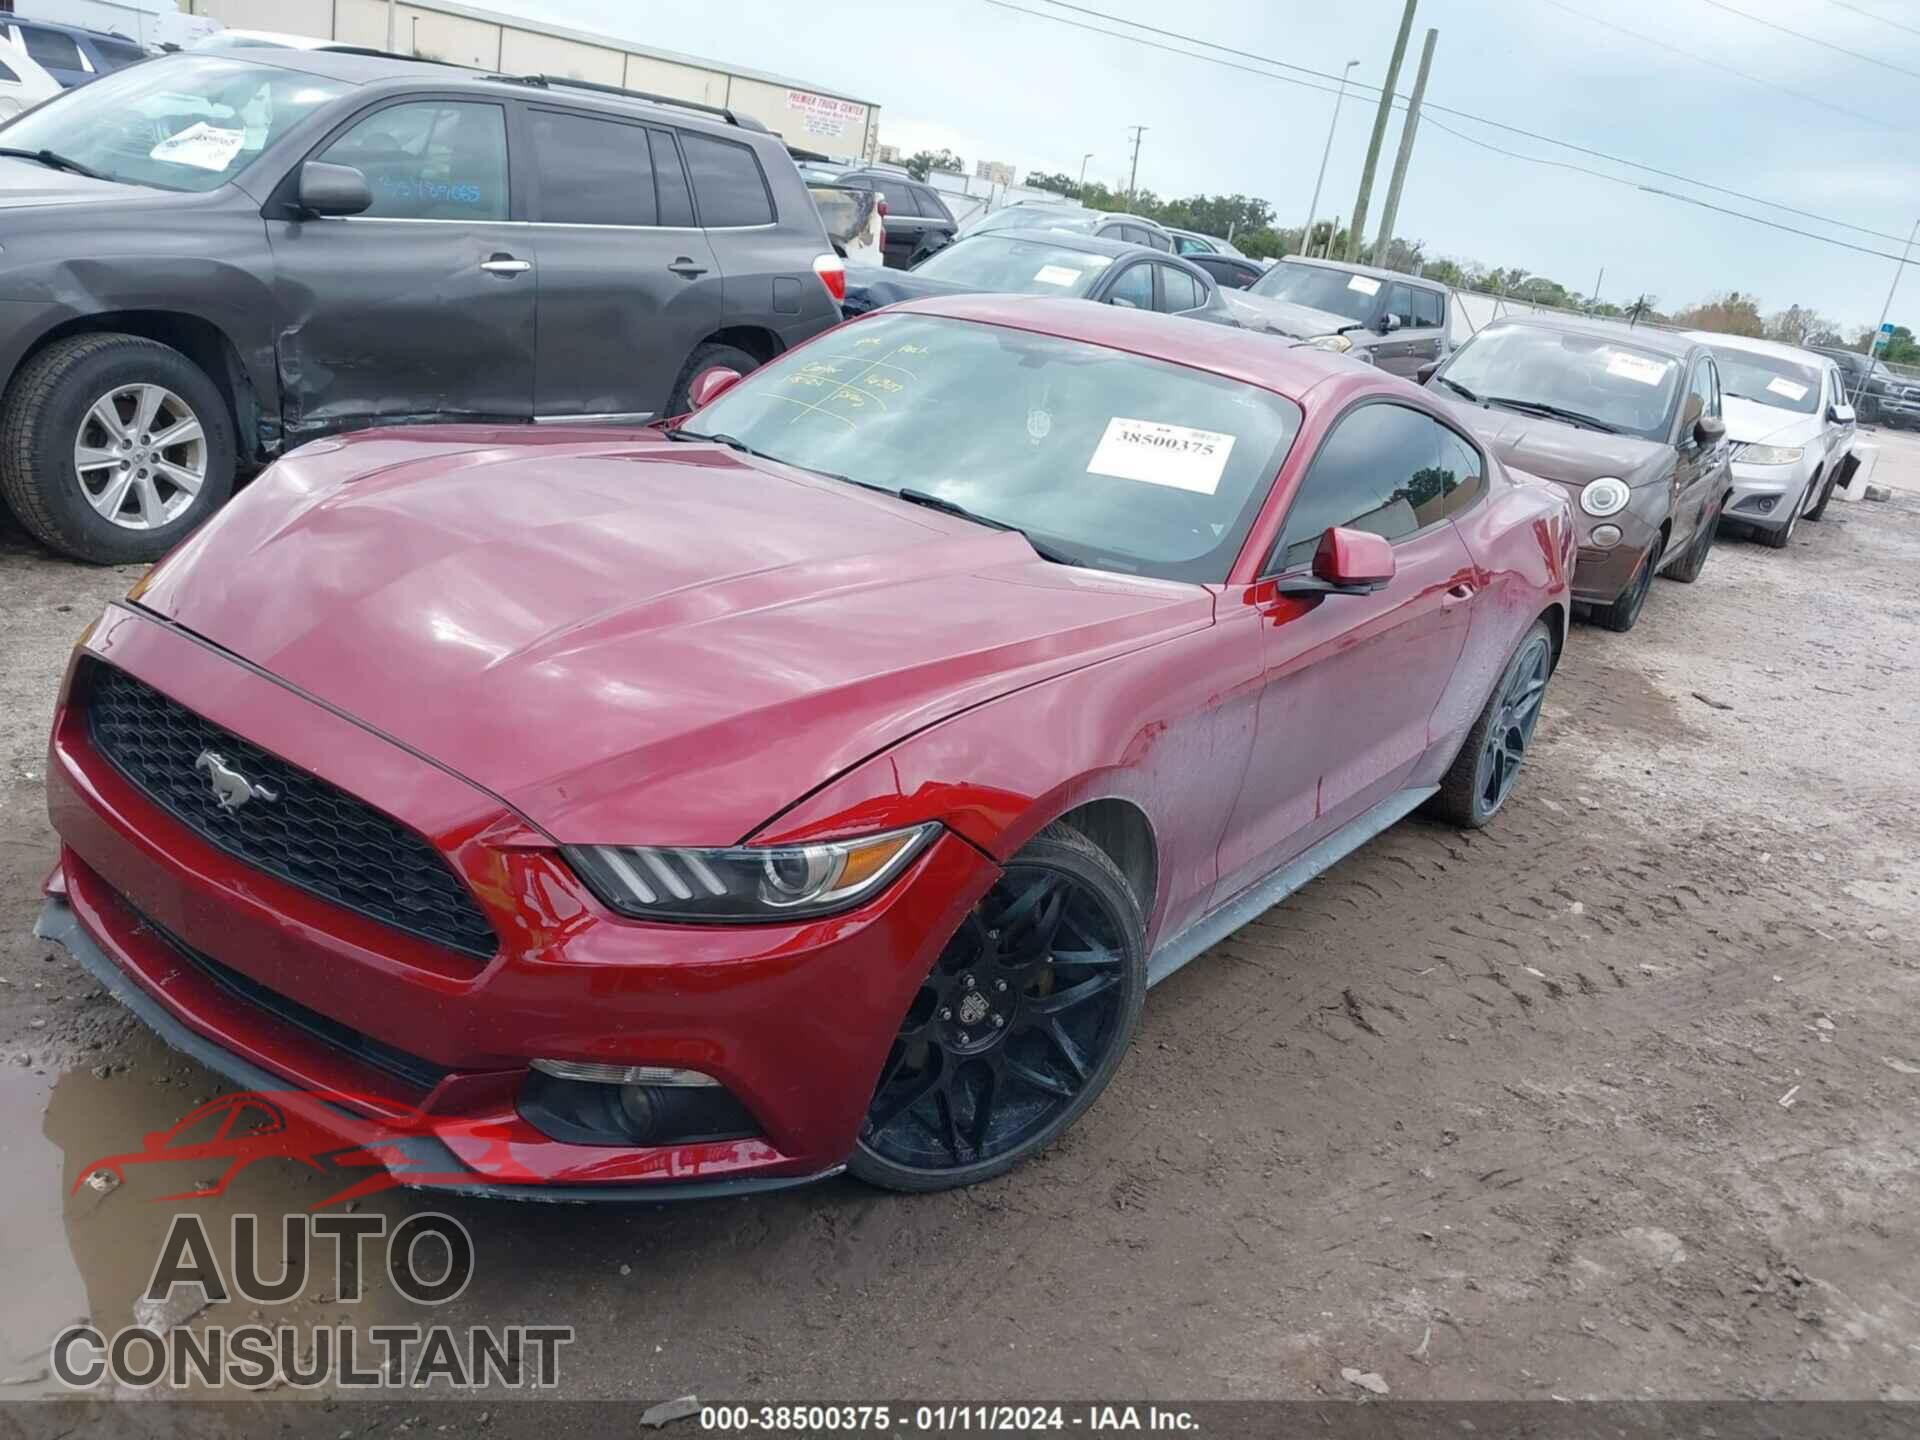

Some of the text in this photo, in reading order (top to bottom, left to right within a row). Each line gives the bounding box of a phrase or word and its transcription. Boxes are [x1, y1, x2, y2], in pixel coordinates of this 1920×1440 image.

[790, 92, 817, 106] PREMIER
[817, 98, 838, 111] TRUCK
[839, 103, 865, 116] CENTER
[1116, 430, 1215, 456] 38500375
